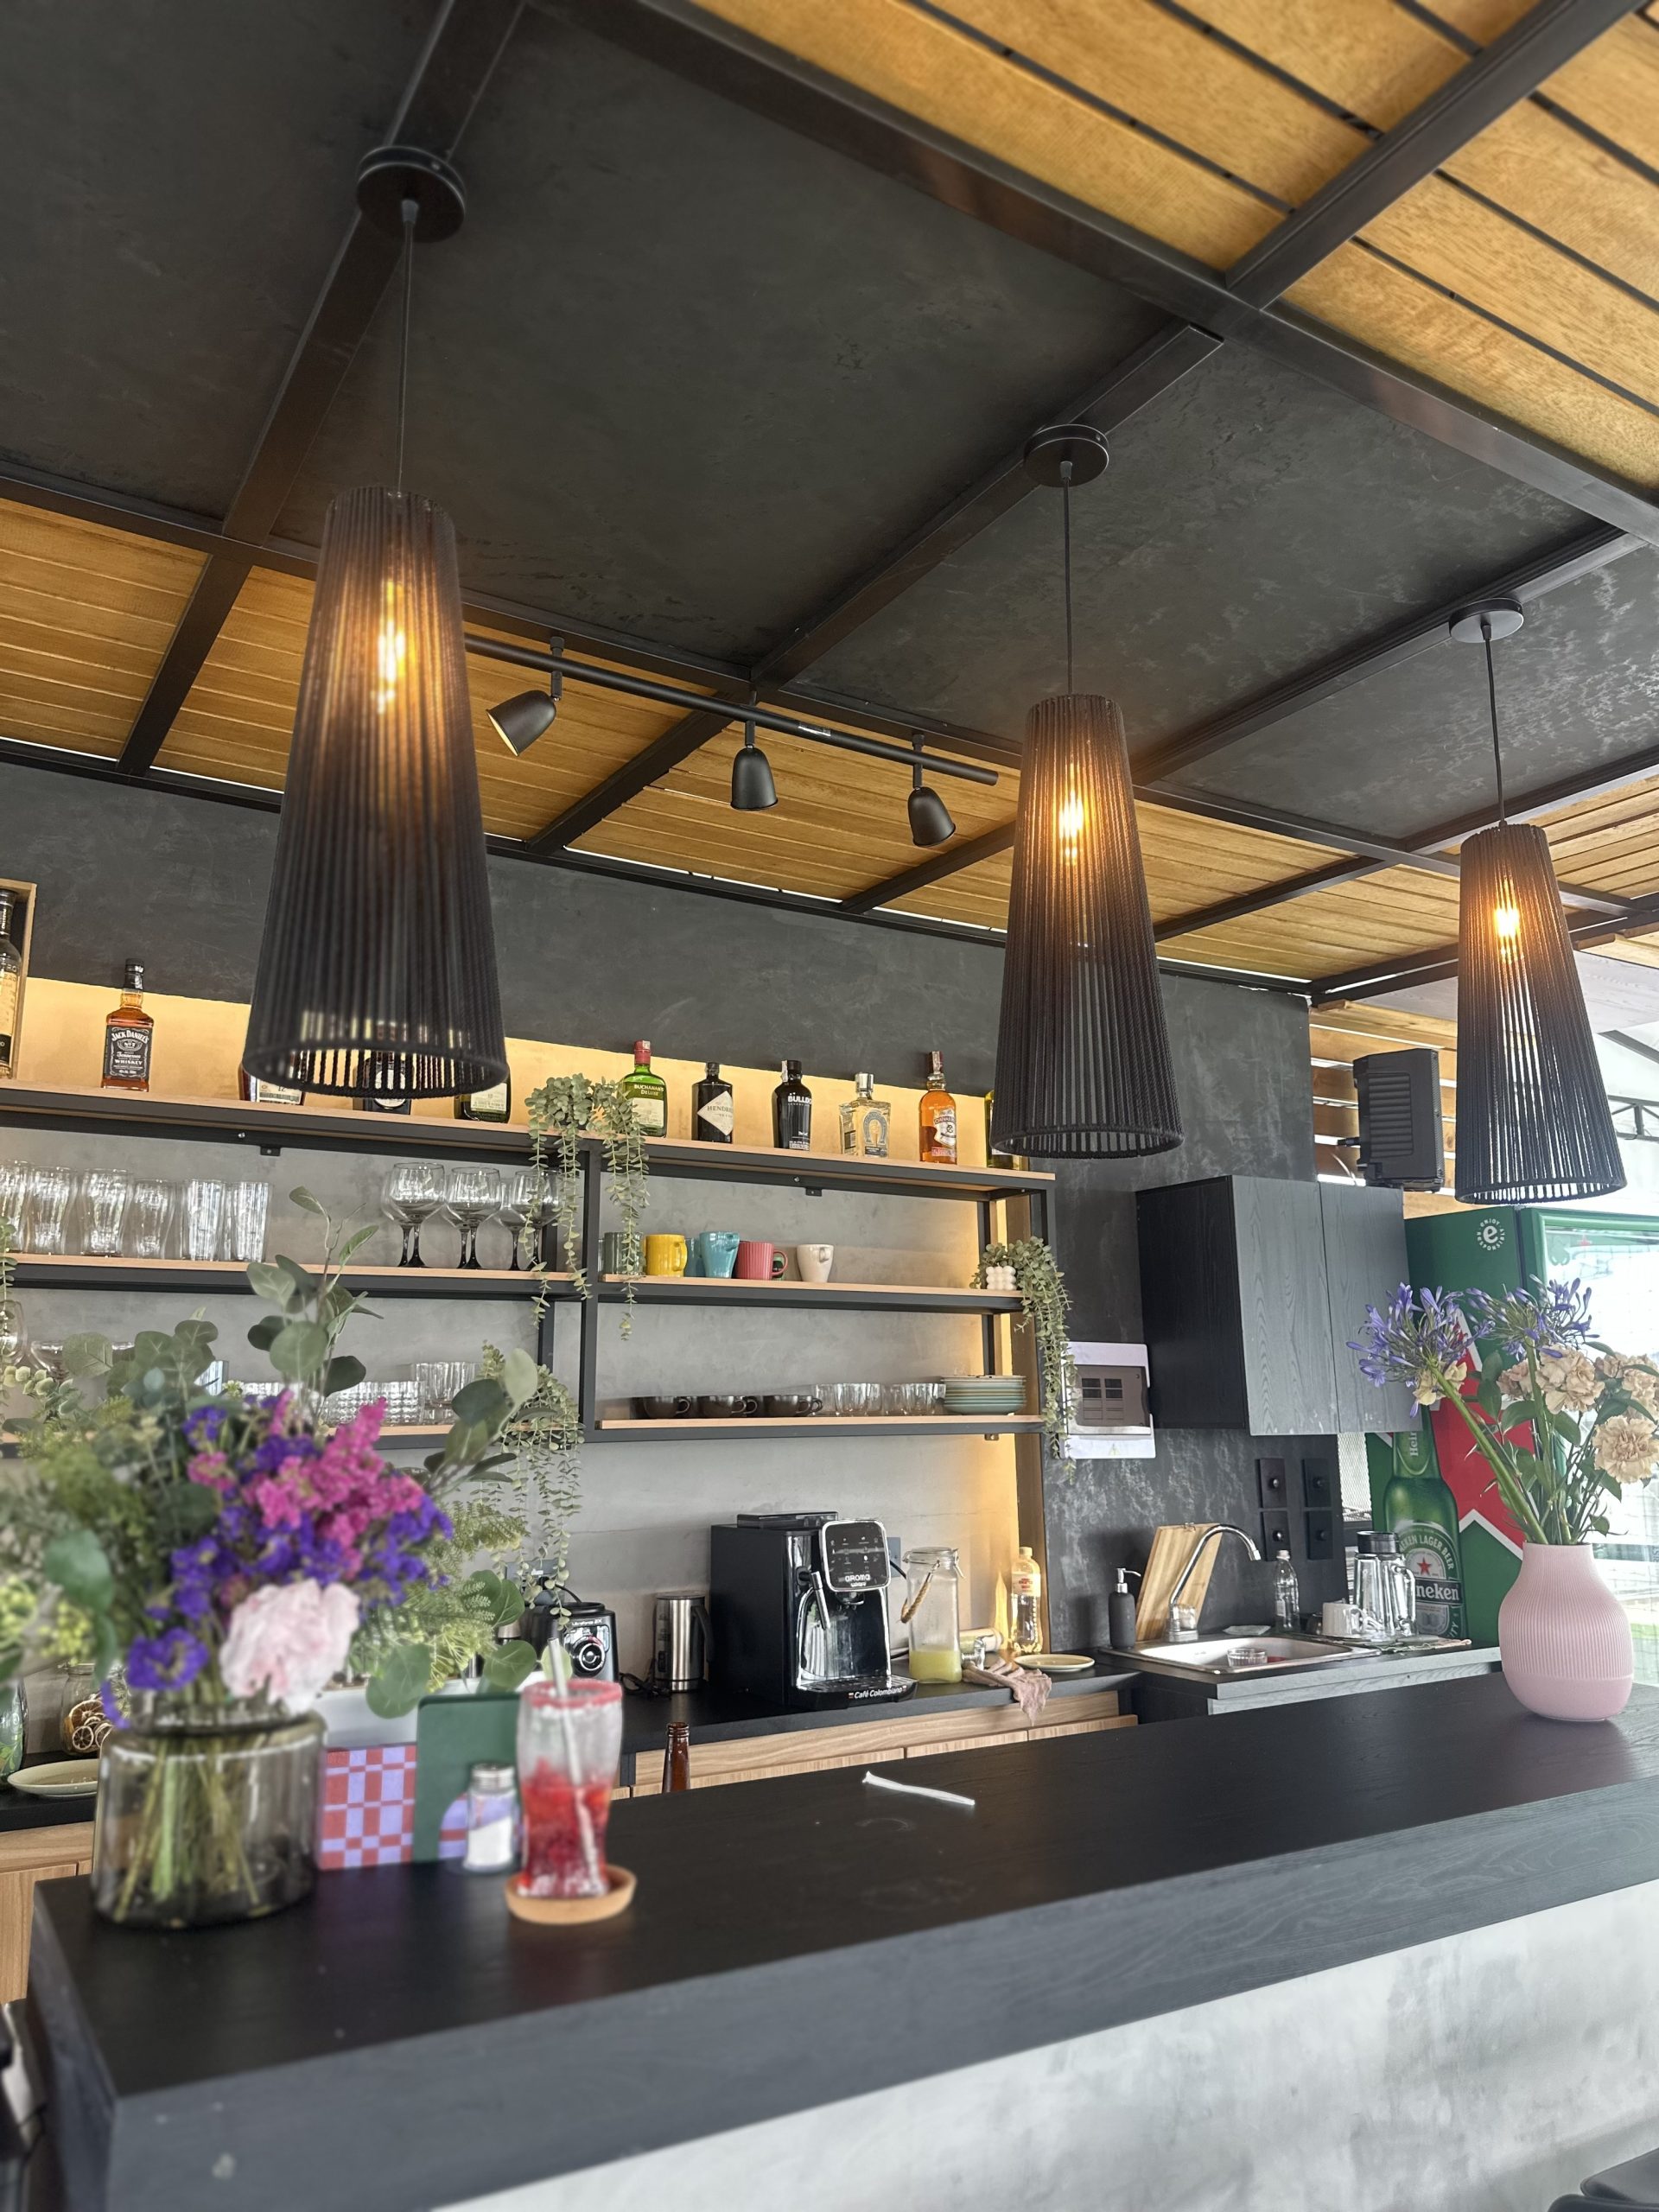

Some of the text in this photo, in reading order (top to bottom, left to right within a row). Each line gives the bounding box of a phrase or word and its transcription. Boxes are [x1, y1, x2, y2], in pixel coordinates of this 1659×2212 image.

[111, 1032, 126, 1041] JACK
[1419, 1535, 1443, 1551] LAGER
[1441, 1547, 1455, 1570] BEER
[854, 1687, 903, 1699] Café Colombiano
